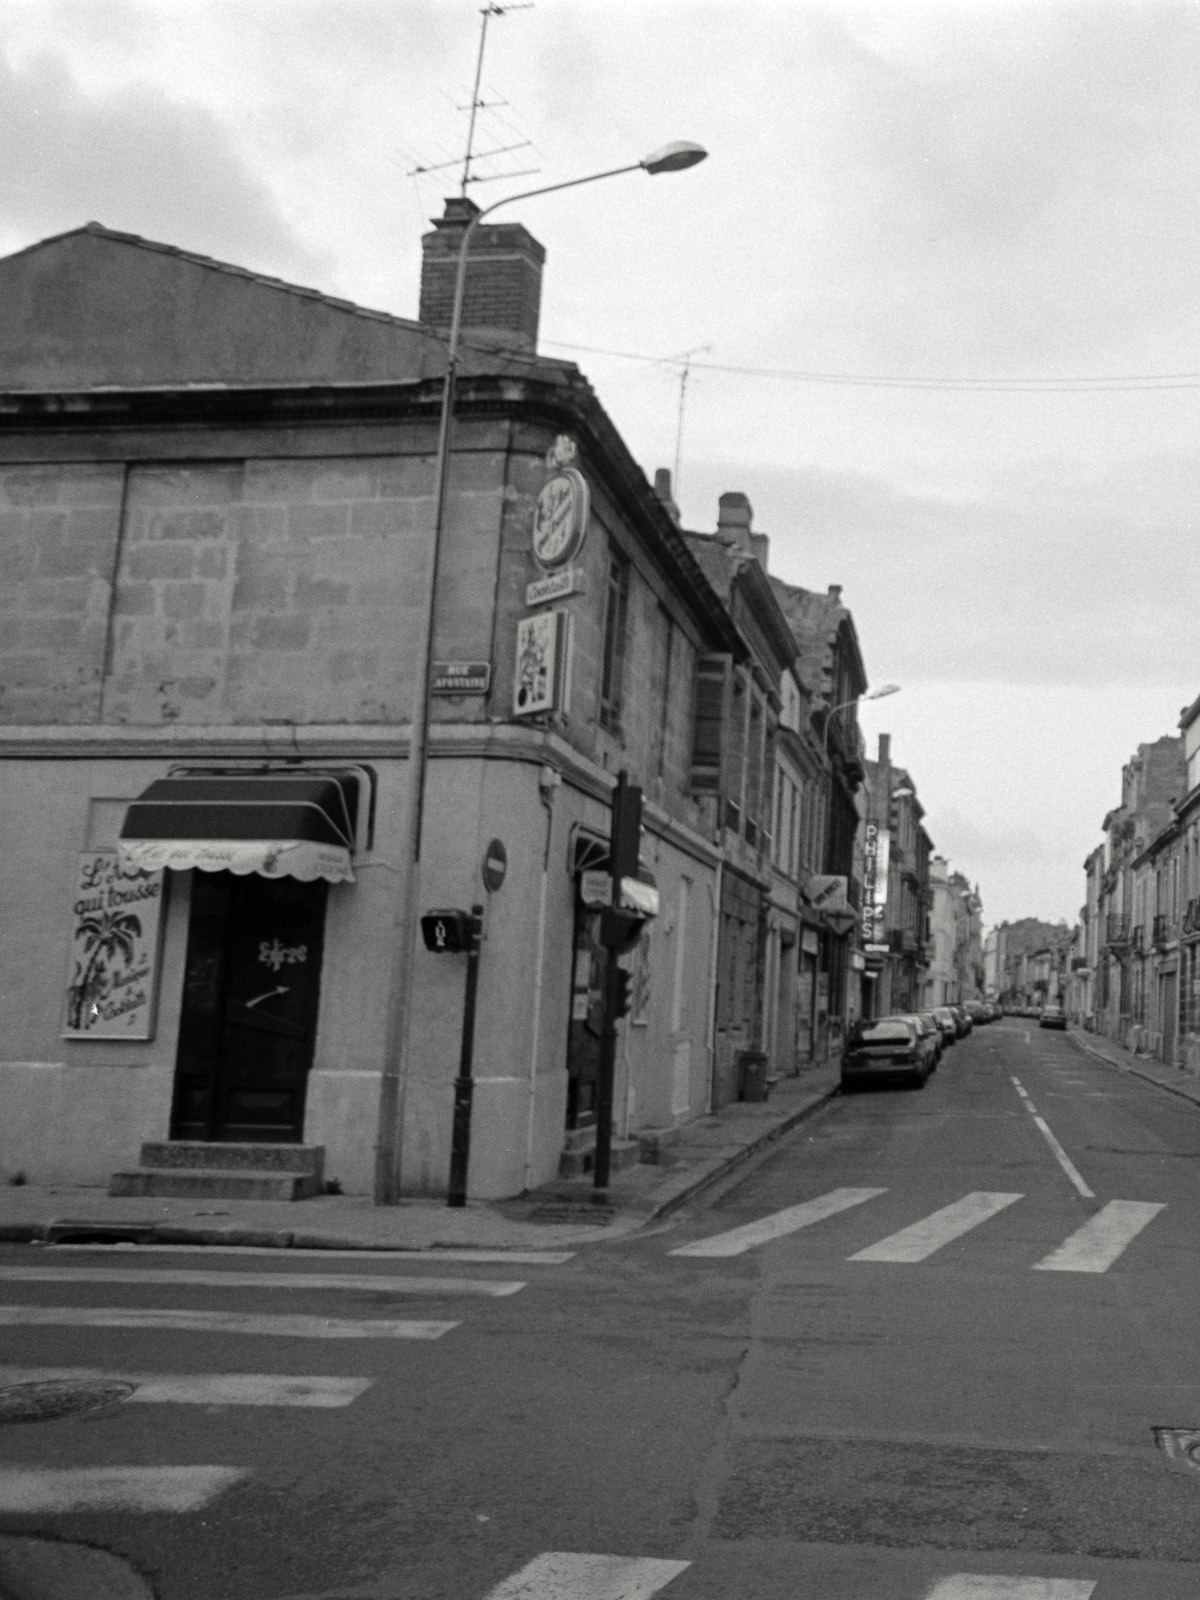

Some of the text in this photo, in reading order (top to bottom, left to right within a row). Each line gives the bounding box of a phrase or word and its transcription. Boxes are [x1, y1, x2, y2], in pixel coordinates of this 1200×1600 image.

[448, 665, 470, 676] RUE
[433, 677, 485, 688] AFONTAINE
[862, 824, 877, 939] PHILIPS
